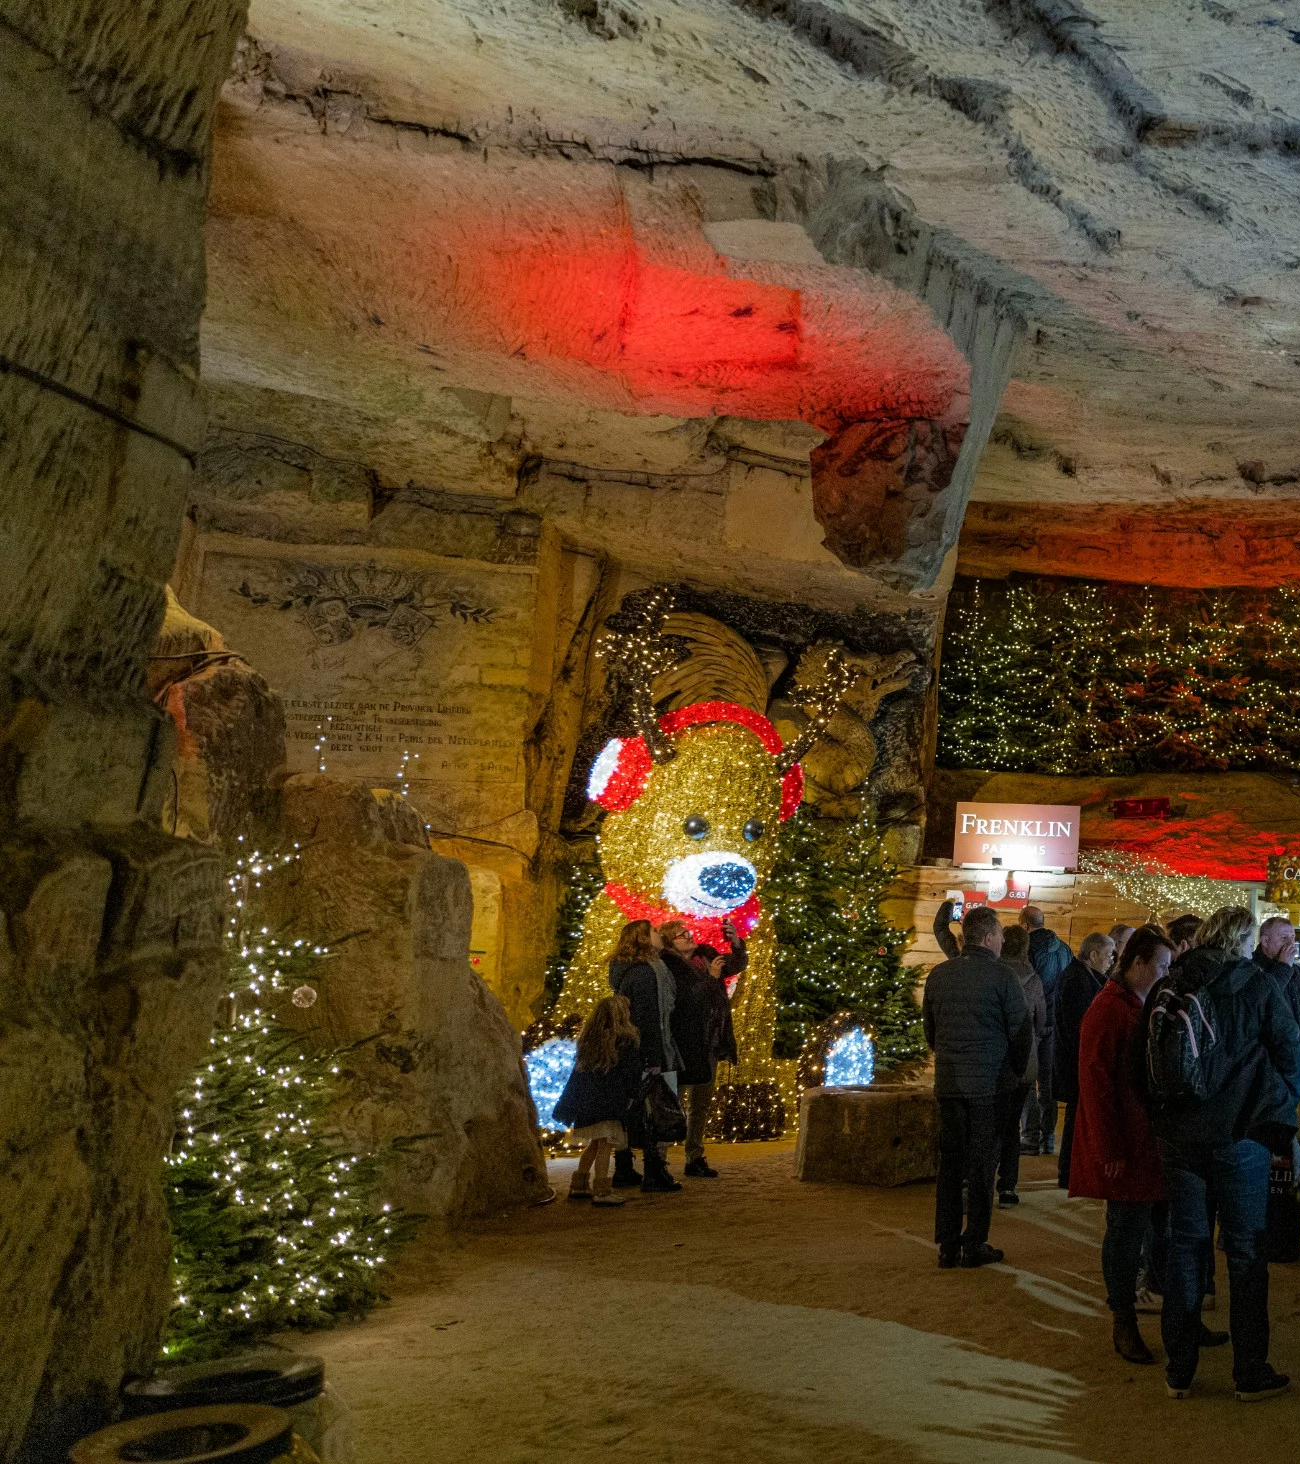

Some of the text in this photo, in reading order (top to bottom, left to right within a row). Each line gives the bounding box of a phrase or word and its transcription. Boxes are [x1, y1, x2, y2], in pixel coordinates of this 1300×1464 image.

[324, 701, 354, 710] BEZOEK
[358, 702, 376, 710] AAN
[330, 744, 353, 752] DEZE
[960, 814, 1072, 838] FRENKLIN
